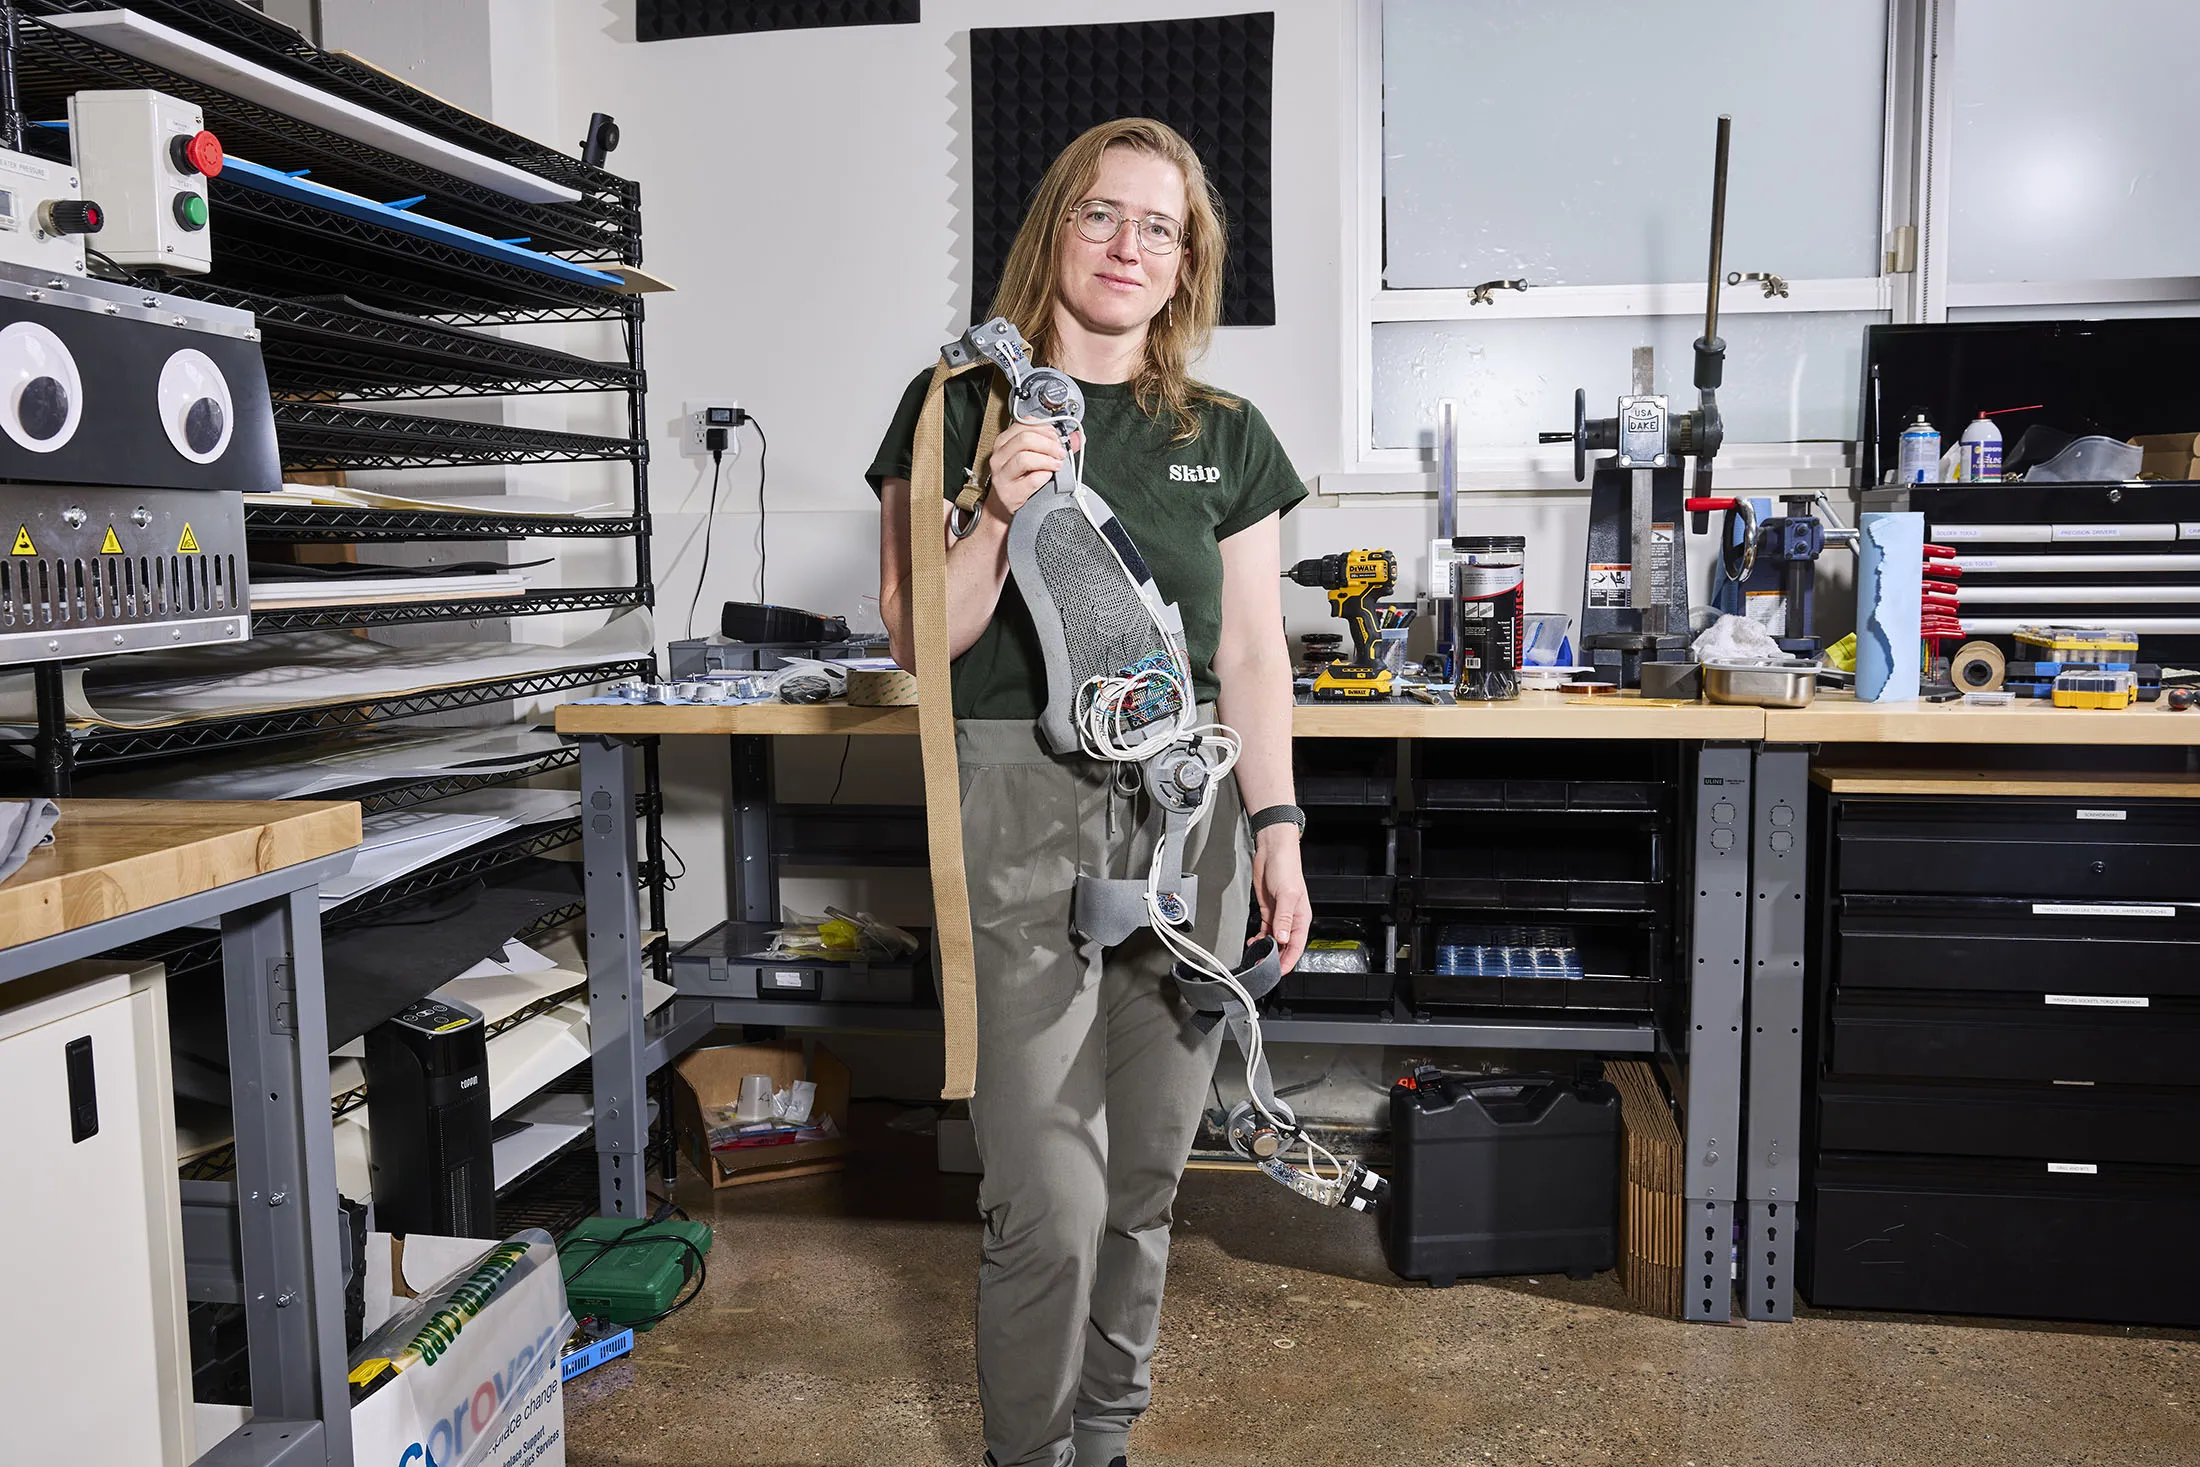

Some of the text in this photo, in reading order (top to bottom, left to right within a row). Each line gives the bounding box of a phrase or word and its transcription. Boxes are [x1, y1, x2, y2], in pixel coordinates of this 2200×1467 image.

[1630, 421, 1656, 431] DAKE
[1634, 409, 1653, 417] USA
[1168, 464, 1221, 483] Skip
[1514, 589, 1524, 668] STANDARD
[523, 1379, 558, 1420] change
[523, 1425, 545, 1454] Support
[536, 1430, 560, 1458] Services
